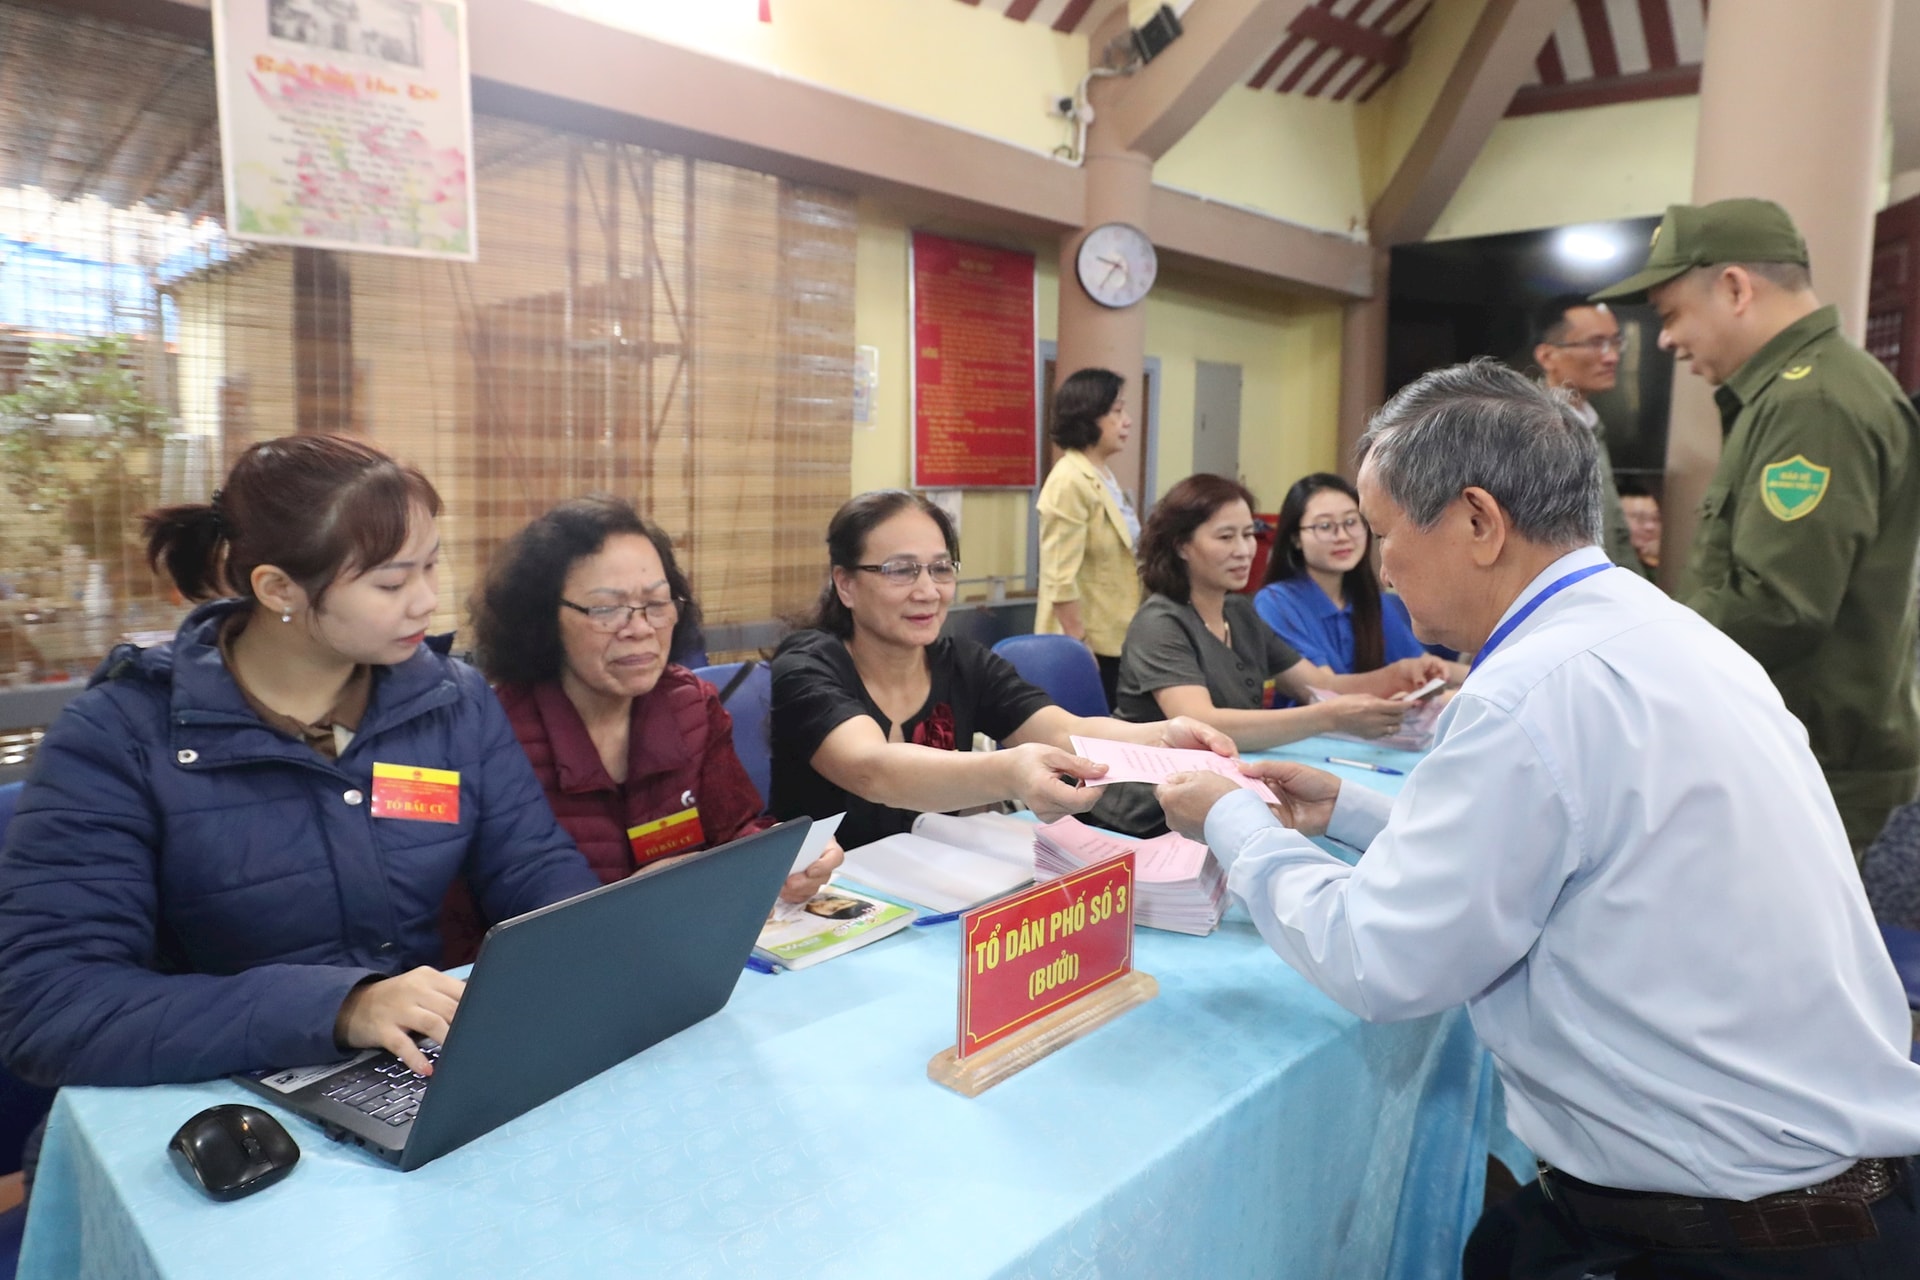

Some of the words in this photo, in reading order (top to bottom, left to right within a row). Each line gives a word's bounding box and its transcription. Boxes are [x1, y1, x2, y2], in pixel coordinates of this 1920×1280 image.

[975, 923, 1001, 975] TỔ
[1005, 918, 1045, 962] DÂN
[1050, 890, 1086, 943] PHỐ
[1090, 880, 1113, 925] SỐ
[1116, 885, 1127, 914] 3
[1028, 950, 1080, 1001] (BƯỞI)
